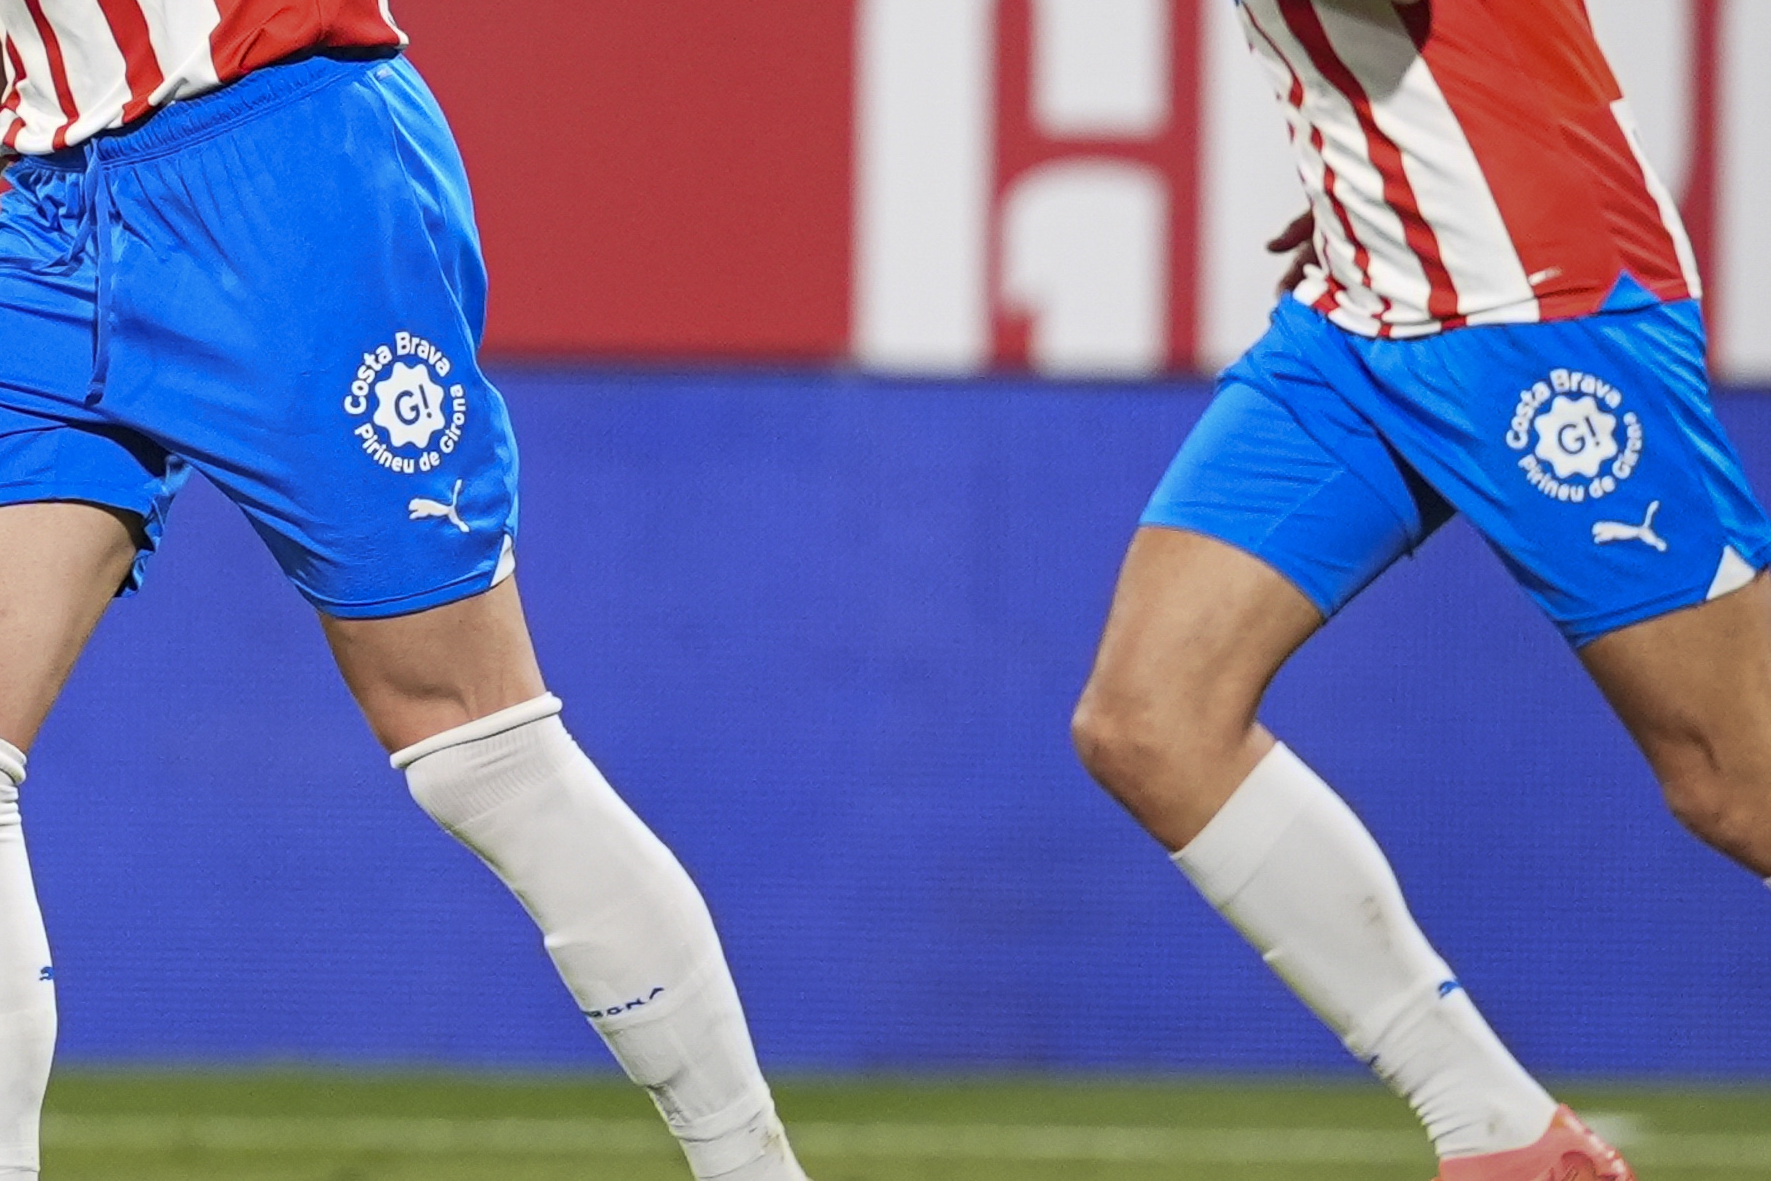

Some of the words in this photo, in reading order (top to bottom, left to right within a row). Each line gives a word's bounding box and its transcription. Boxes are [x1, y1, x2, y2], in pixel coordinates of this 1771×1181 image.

[344, 345, 392, 414] Costa
[395, 331, 450, 377] Brava
[1549, 368, 1622, 410] Brava
[354, 423, 415, 473] Pirineu
[419, 451, 440, 472] de
[439, 384, 466, 454] Girona
